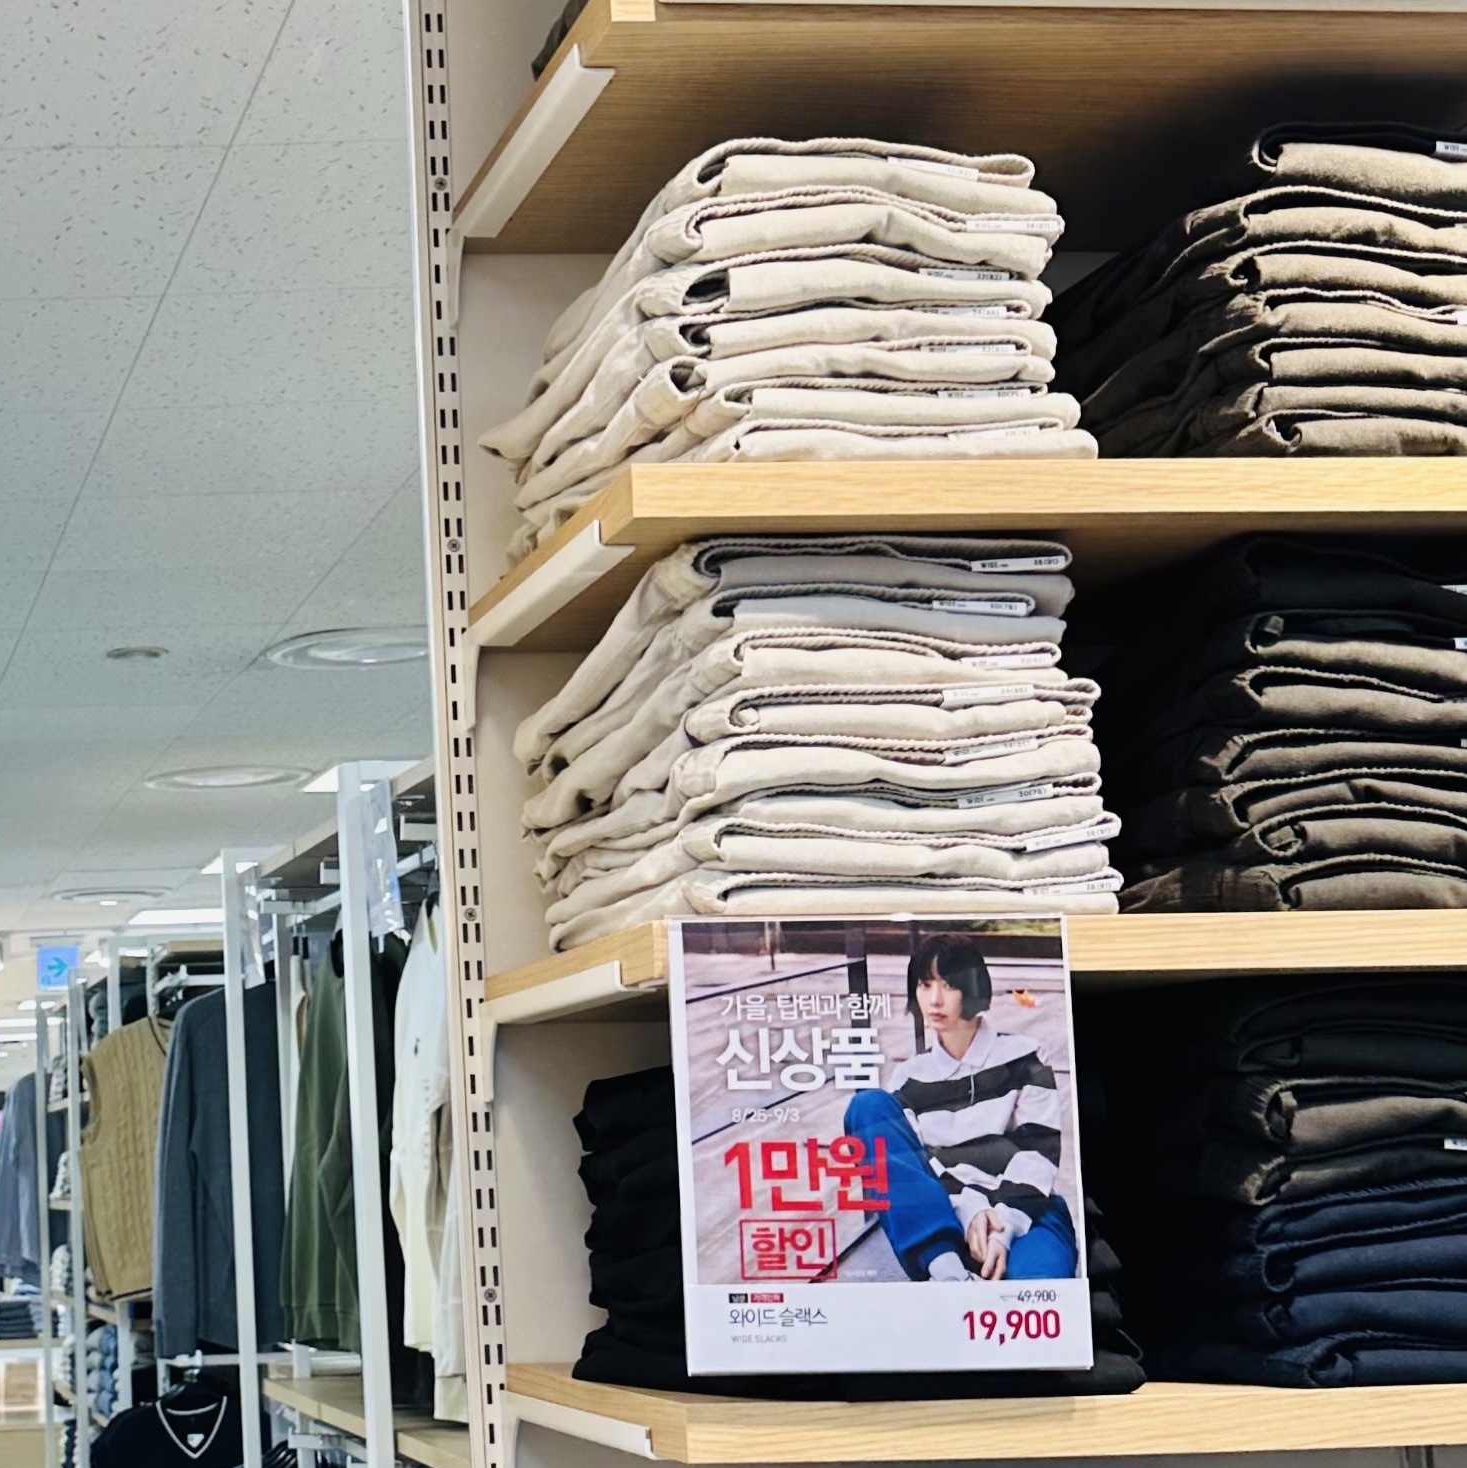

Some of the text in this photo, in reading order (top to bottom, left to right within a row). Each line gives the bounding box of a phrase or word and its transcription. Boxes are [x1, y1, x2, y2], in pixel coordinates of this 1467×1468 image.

[721, 992, 892, 1023] 가을, 탑텐과 함께
[715, 1026, 886, 1092] 신상품
[731, 1107, 800, 1124] 8/25-9/3
[723, 1133, 891, 1212] 1만원
[750, 1226, 829, 1272] 할인
[1017, 1289, 1057, 1304] 49,900
[729, 1307, 828, 1328] 와이드 슬랙스
[962, 1308, 1062, 1346] 19,900
